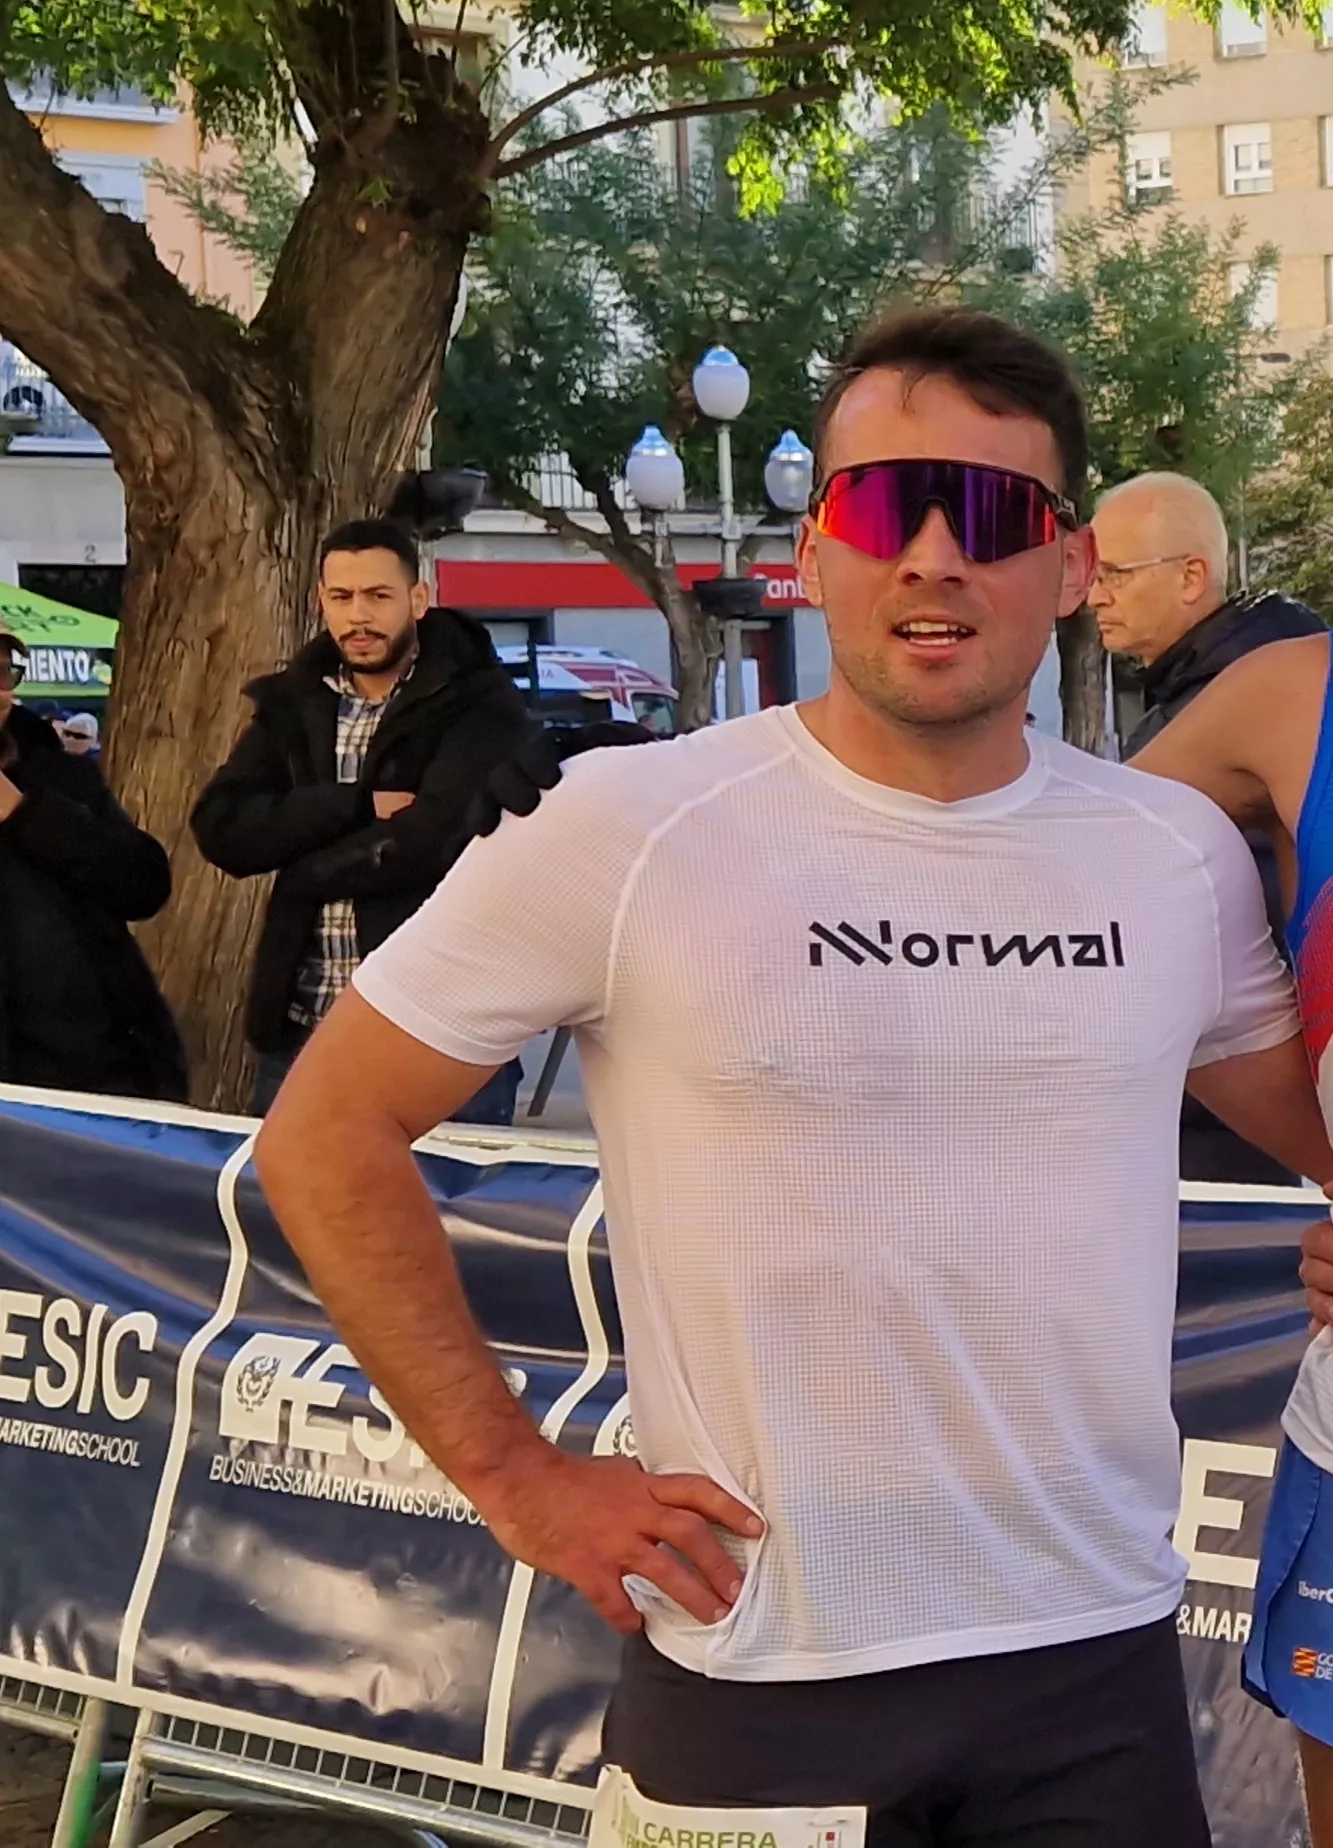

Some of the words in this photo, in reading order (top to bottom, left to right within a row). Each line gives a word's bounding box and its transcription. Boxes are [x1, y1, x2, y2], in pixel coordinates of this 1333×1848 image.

[0, 1289, 158, 1421] ESIC
[0, 1416, 142, 1467] ARKETINGSCHOOL
[1315, 1666, 1333, 1680] DE
[643, 1822, 778, 1848] CARRERA
